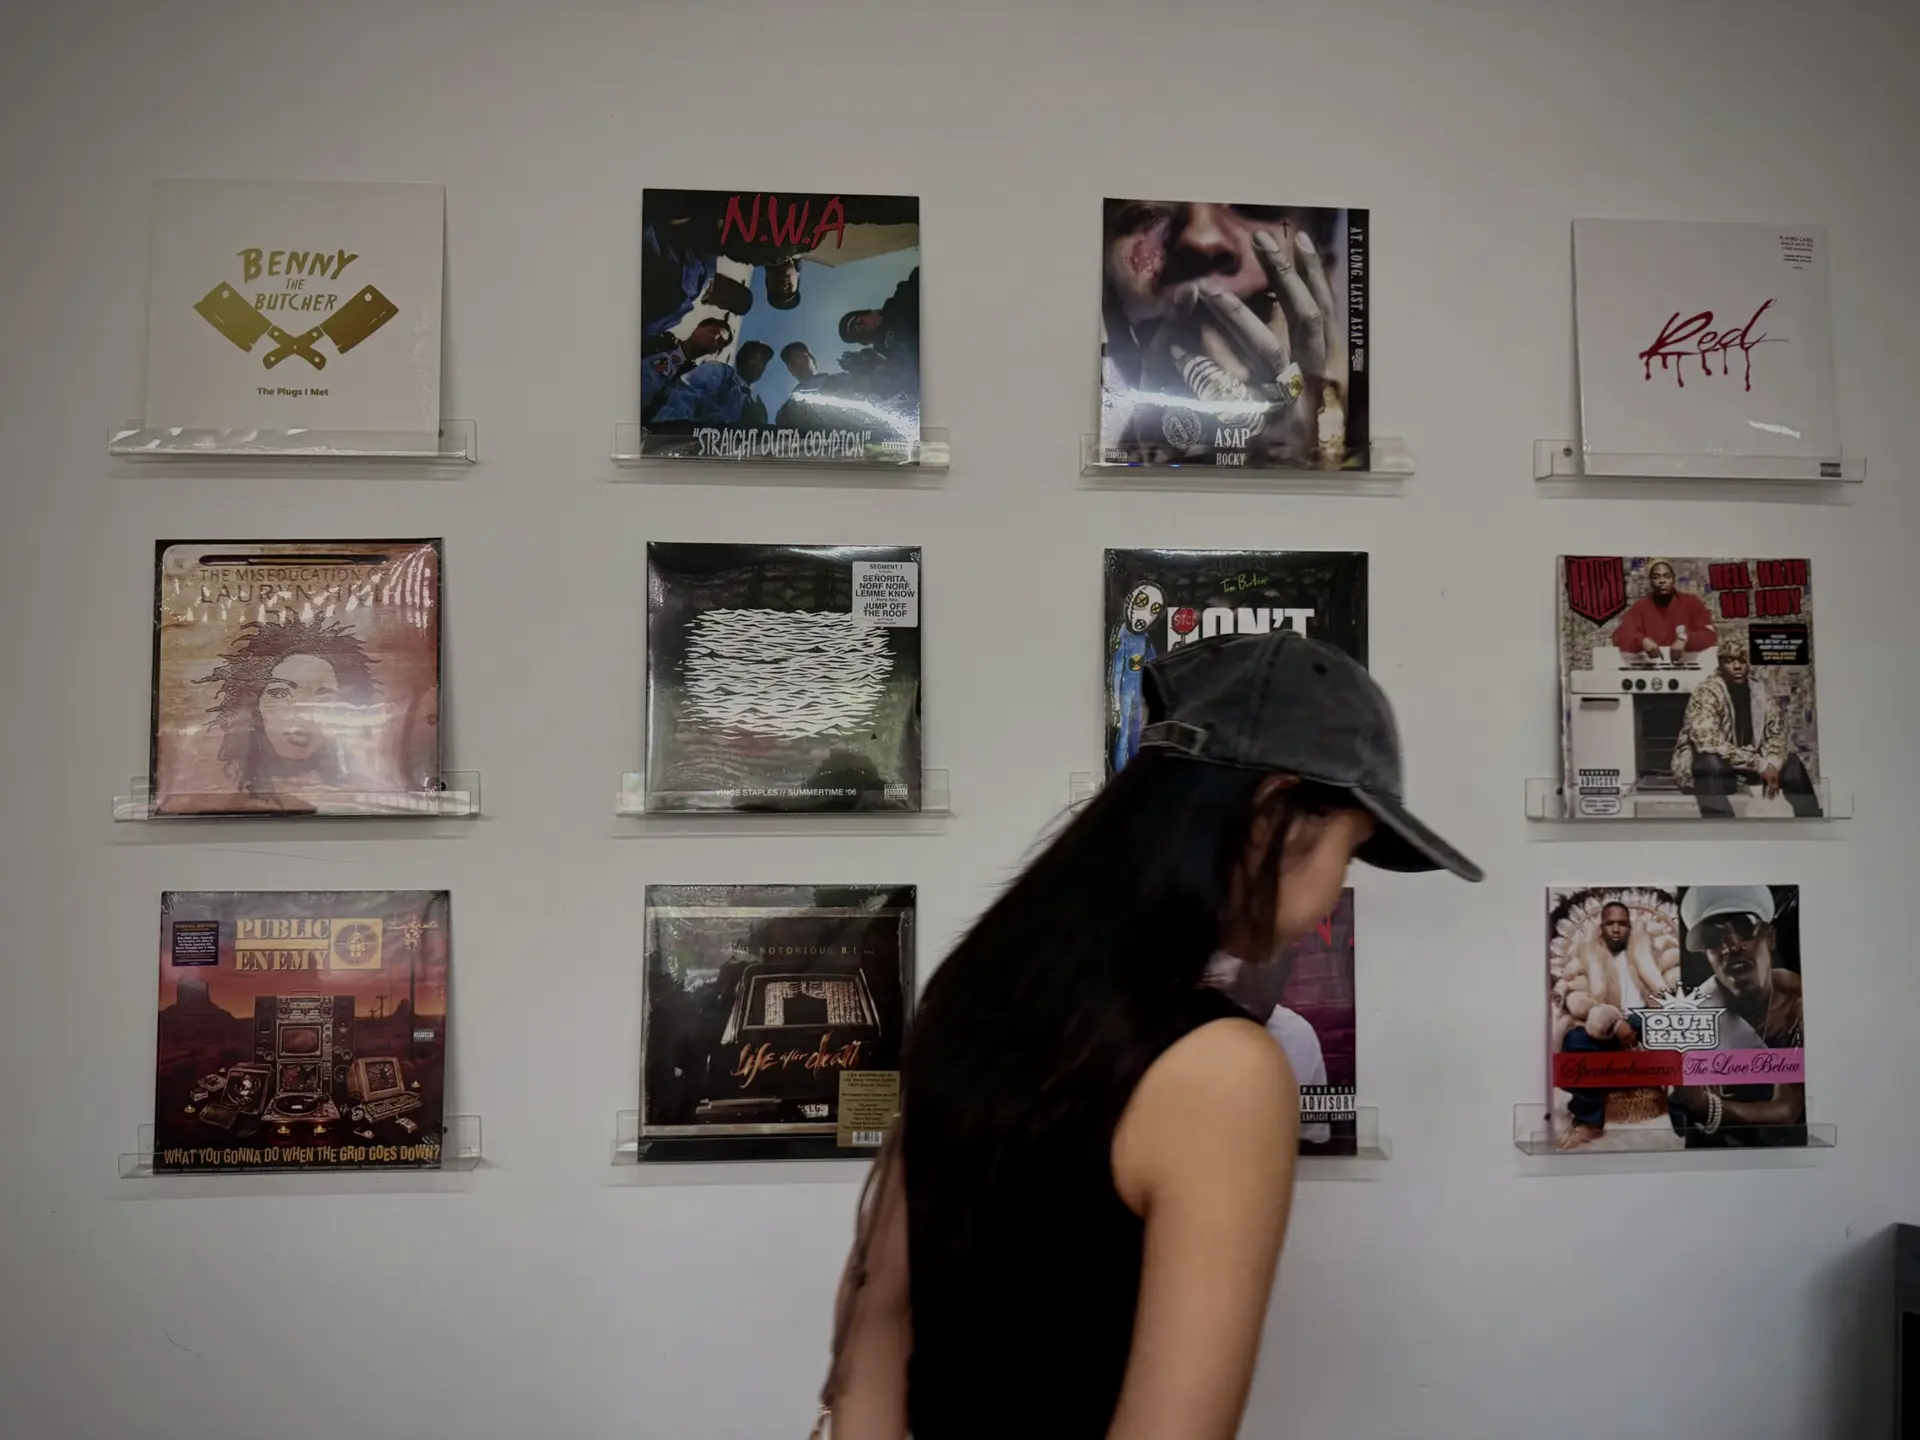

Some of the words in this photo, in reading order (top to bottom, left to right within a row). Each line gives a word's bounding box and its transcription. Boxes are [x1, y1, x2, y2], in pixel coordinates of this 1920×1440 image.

[720, 193, 845, 250] N.W.A
[237, 248, 359, 284] BENNY
[1350, 248, 1363, 279] LONG.
[285, 278, 306, 290] THE
[254, 293, 338, 311] BUTCHER
[1350, 283, 1363, 313] LAST.
[1639, 298, 1789, 391] Red
[256, 387, 275, 396] The
[277, 387, 303, 398] Plugs
[305, 388, 308, 396] I
[310, 388, 329, 396] Met
[693, 427, 758, 460] "STRAIGHT
[761, 429, 800, 458] OUTTA
[803, 429, 871, 458] COMPTON"
[1216, 452, 1246, 466] ROCKY
[200, 569, 230, 582] THE
[234, 568, 361, 582] MISEDUCATION
[862, 573, 908, 583] SEÑORITA,
[859, 582, 884, 590] NORF
[1220, 578, 1237, 593] Tim
[201, 584, 313, 603] LAURYN
[888, 590, 915, 598] KNOW
[863, 602, 887, 610] JUMP
[889, 602, 907, 610] OFF
[863, 609, 880, 617] THE
[741, 788, 778, 797] STAPLES
[787, 788, 844, 797] SUMMERTIME
[236, 918, 330, 939] PUBLIC
[234, 950, 329, 971] ENEMY
[1646, 1013, 1714, 1030] OUT
[1646, 1030, 1715, 1044] KAST
[780, 1047, 809, 1070] after
[1684, 1057, 1708, 1076] The
[1710, 1053, 1749, 1076] Love
[1750, 1053, 1800, 1074] Below
[1302, 1086, 1355, 1094] PARENTAL
[1302, 1095, 1355, 1110] ADVISORY
[1302, 1112, 1328, 1121] EXPLICIT
[164, 1149, 195, 1165] WHAT
[199, 1148, 220, 1165] YOU
[223, 1147, 261, 1164] GONNA
[264, 1147, 280, 1163] DO
[282, 1146, 315, 1162] WHEN
[317, 1145, 337, 1163] THE
[339, 1145, 366, 1162] GRID
[368, 1144, 397, 1161] GOES
[400, 1144, 440, 1161] DOWN?
